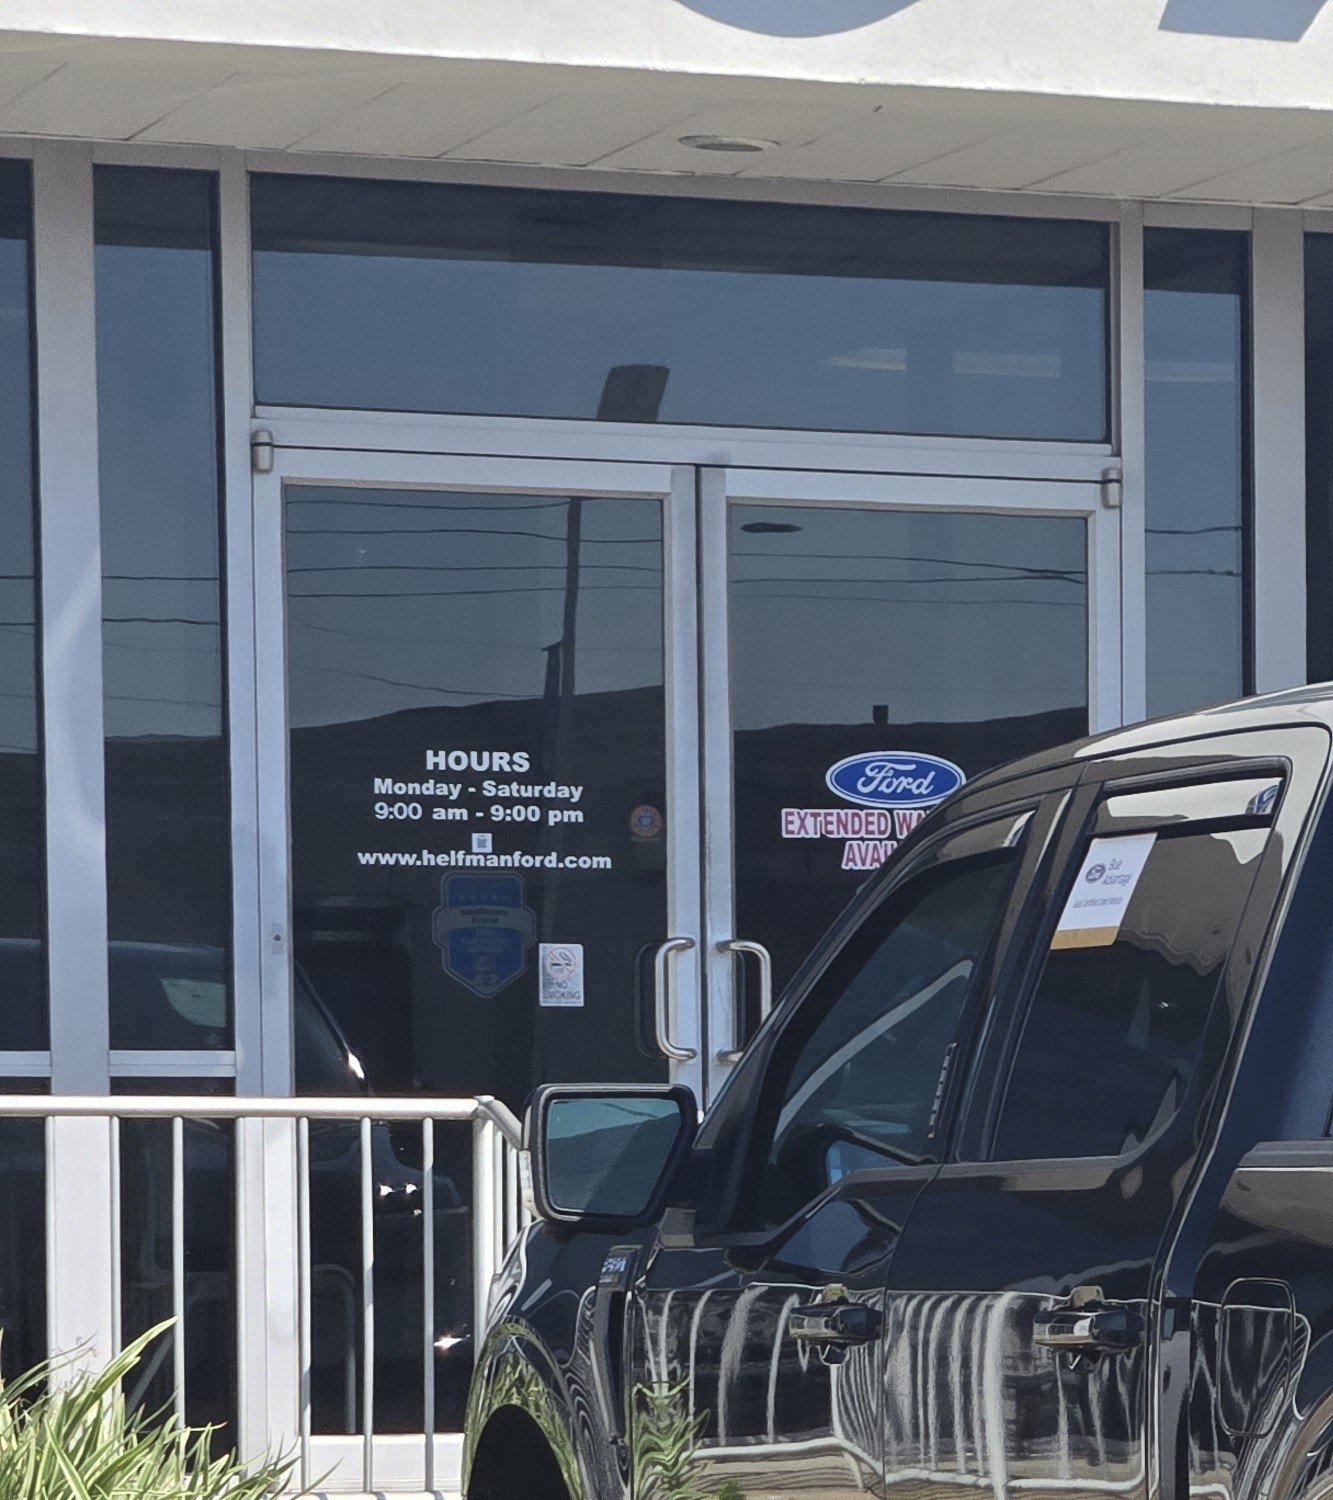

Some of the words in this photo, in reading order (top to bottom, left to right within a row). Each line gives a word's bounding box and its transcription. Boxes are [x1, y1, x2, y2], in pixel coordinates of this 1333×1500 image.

[426, 749, 530, 773] HOURS
[374, 777, 462, 800] Monday
[482, 780, 584, 802] Saturday
[856, 761, 937, 795] Ford
[374, 802, 423, 821] 9:00
[432, 806, 468, 821] am
[490, 804, 541, 823] 9:00
[548, 807, 584, 826] pm
[782, 808, 891, 838] EXTENDED
[357, 850, 612, 869] www.helfmanford.com
